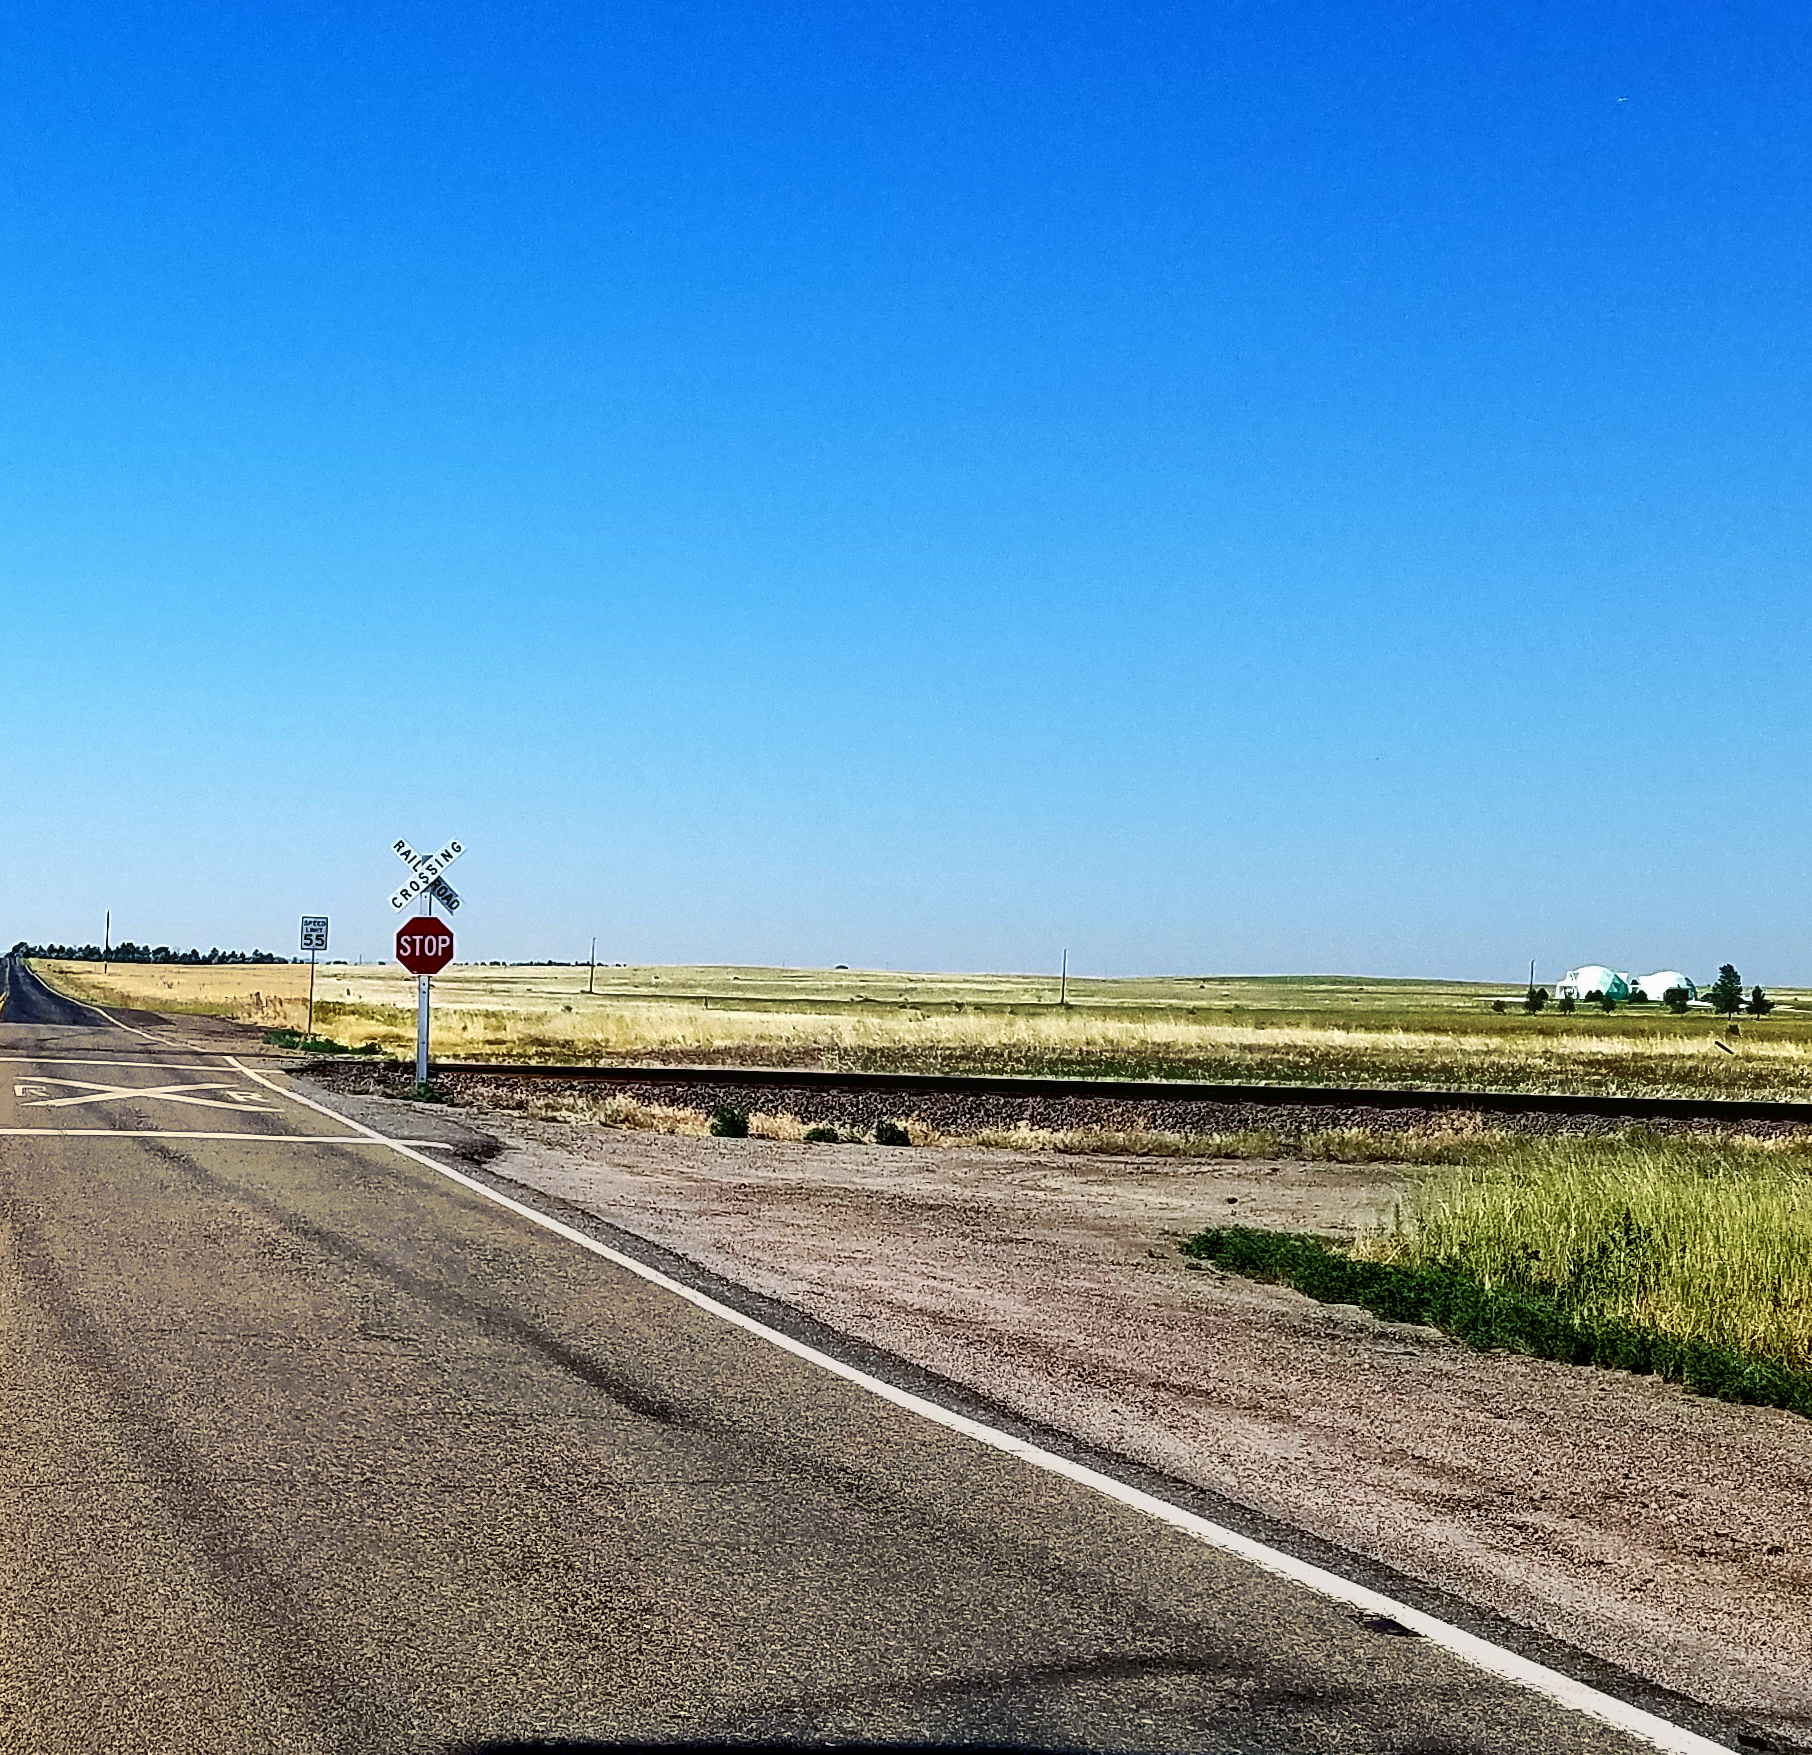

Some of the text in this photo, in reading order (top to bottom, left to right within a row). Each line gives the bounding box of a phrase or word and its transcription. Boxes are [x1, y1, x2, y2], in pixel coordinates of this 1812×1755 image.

[391, 841, 462, 909] CROSSING
[393, 839, 461, 911] RAIL ROAD
[303, 933, 325, 947] 55
[399, 935, 451, 957] STOP
